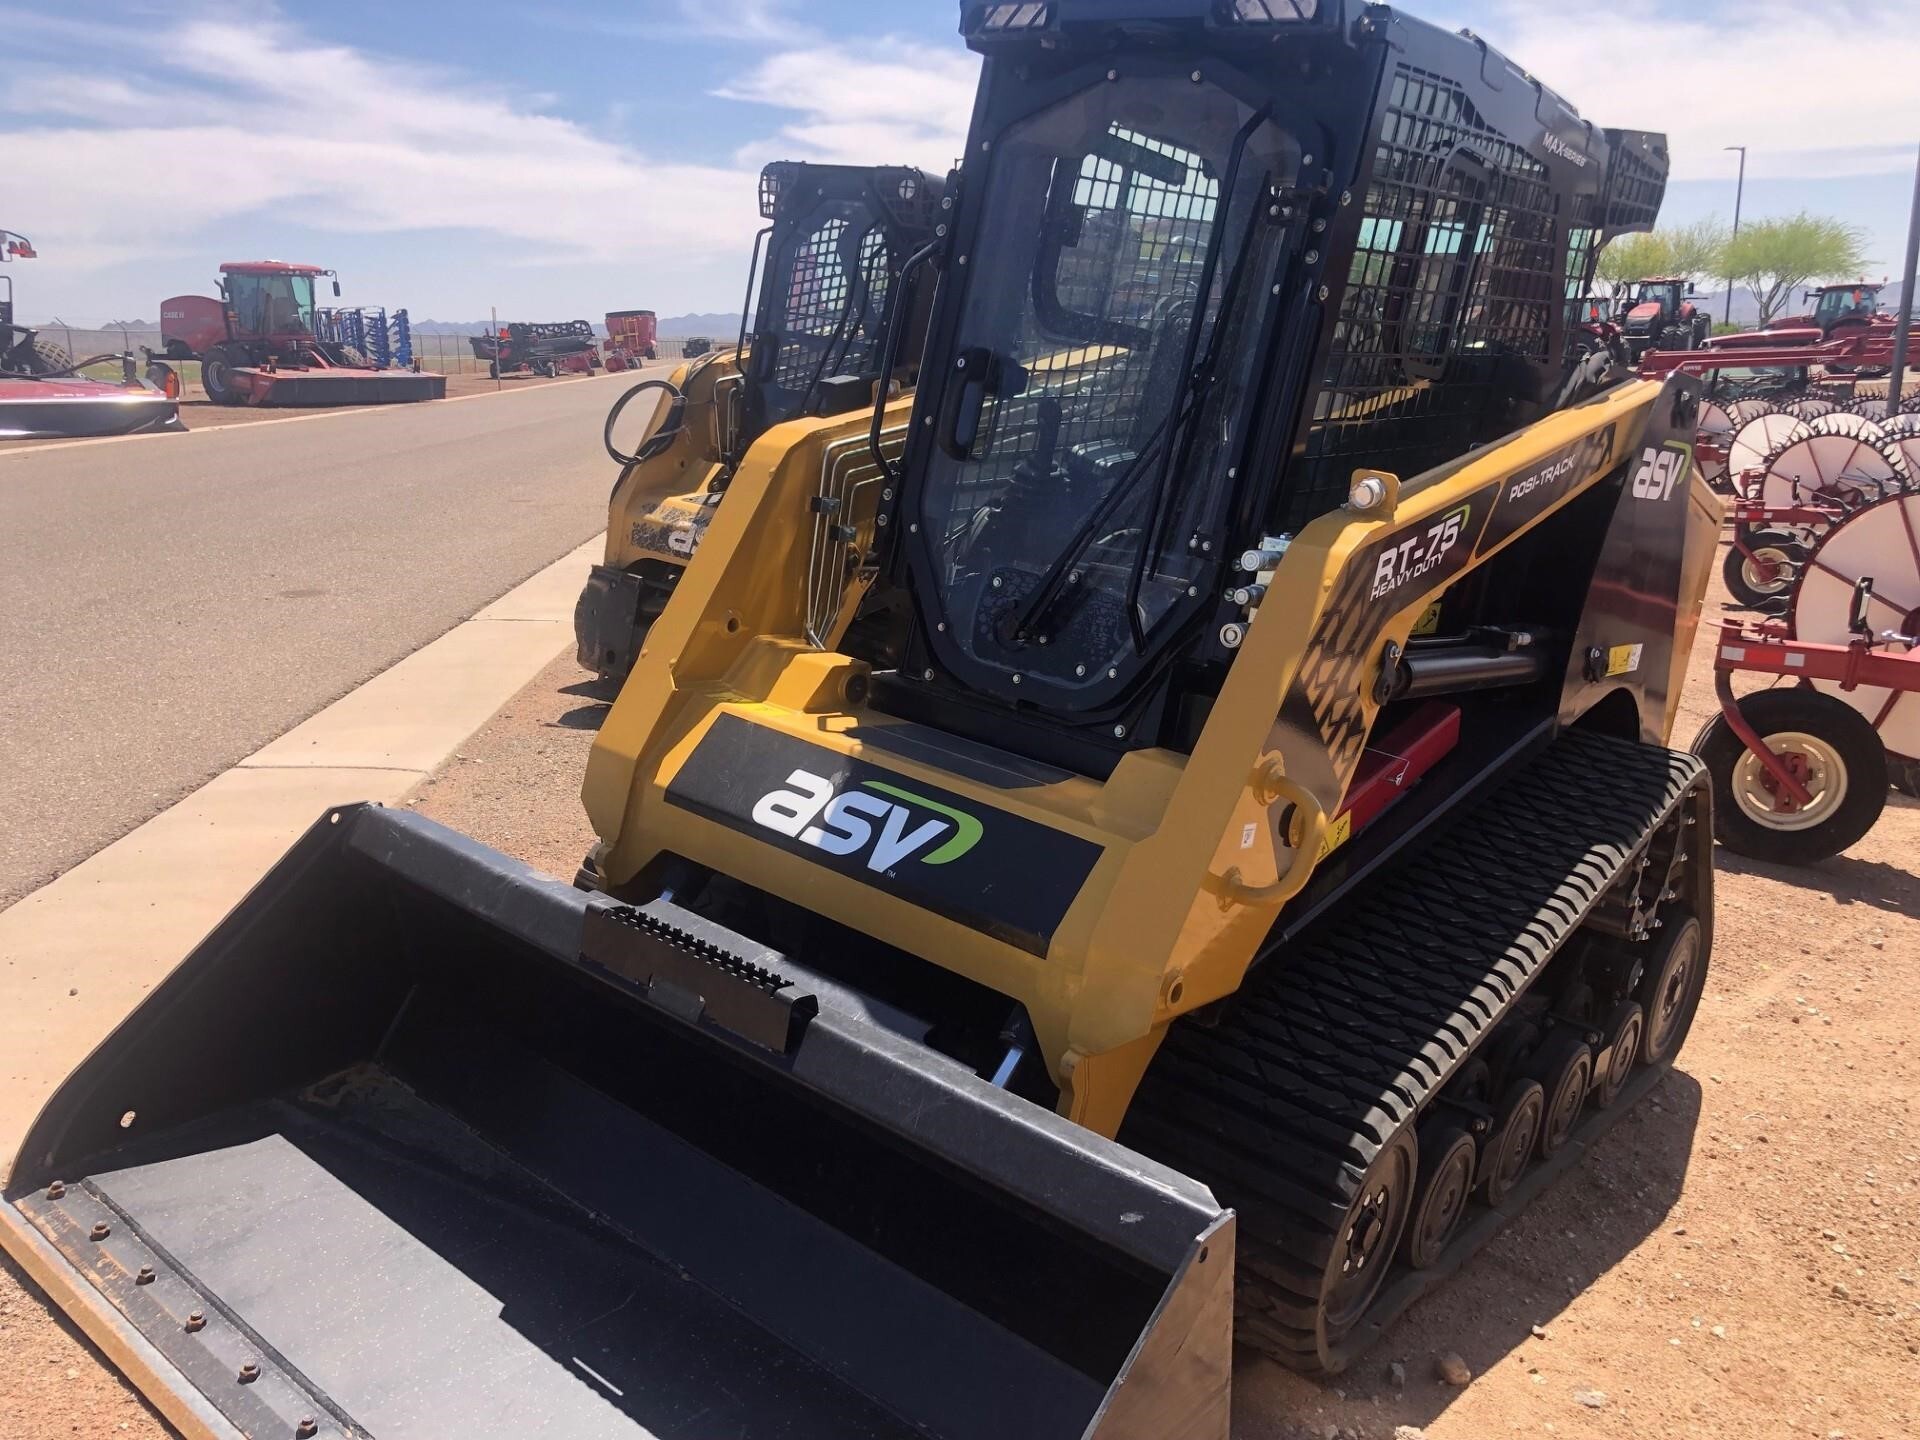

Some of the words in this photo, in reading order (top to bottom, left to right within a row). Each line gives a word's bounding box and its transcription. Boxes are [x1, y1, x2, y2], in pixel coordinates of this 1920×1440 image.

[1509, 454, 1576, 502] POSI-TRACK
[1632, 447, 1685, 501] asv
[1369, 568, 1414, 602] HEAVY
[1413, 550, 1446, 578] DUTY
[1373, 514, 1462, 588] RT-75
